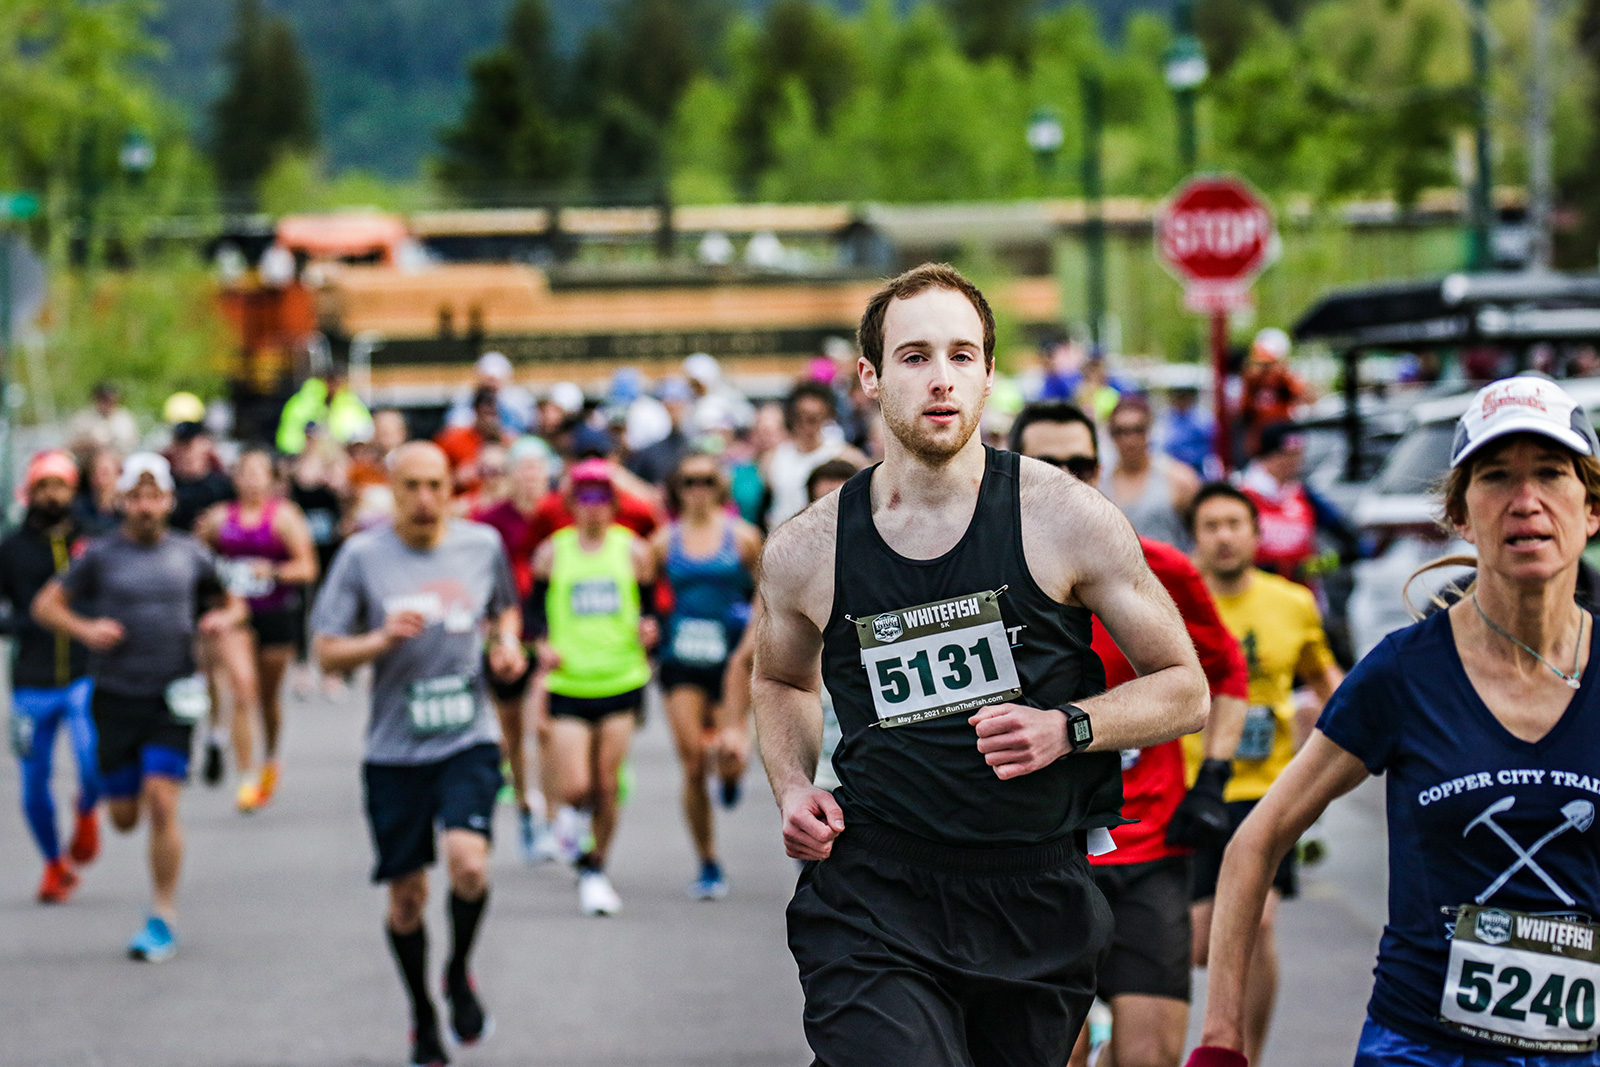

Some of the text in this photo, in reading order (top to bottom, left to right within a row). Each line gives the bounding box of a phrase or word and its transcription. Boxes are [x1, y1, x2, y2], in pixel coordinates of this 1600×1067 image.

[1167, 212, 1261, 252] STOP
[903, 597, 980, 629] WHITEFISH
[941, 621, 950, 629] 5K
[875, 637, 999, 703] 5131
[897, 695, 1004, 724] May 22, 2021 RunTheFish.com
[1418, 769, 1600, 806] COPPER CITY TRAI
[1516, 915, 1594, 951] WHITEFISH
[1456, 959, 1595, 1031] 5240
[1460, 1026, 1477, 1037] May
[1492, 1033, 1511, 1044] 2021
[1517, 1039, 1579, 1051] RunTheFish.com
